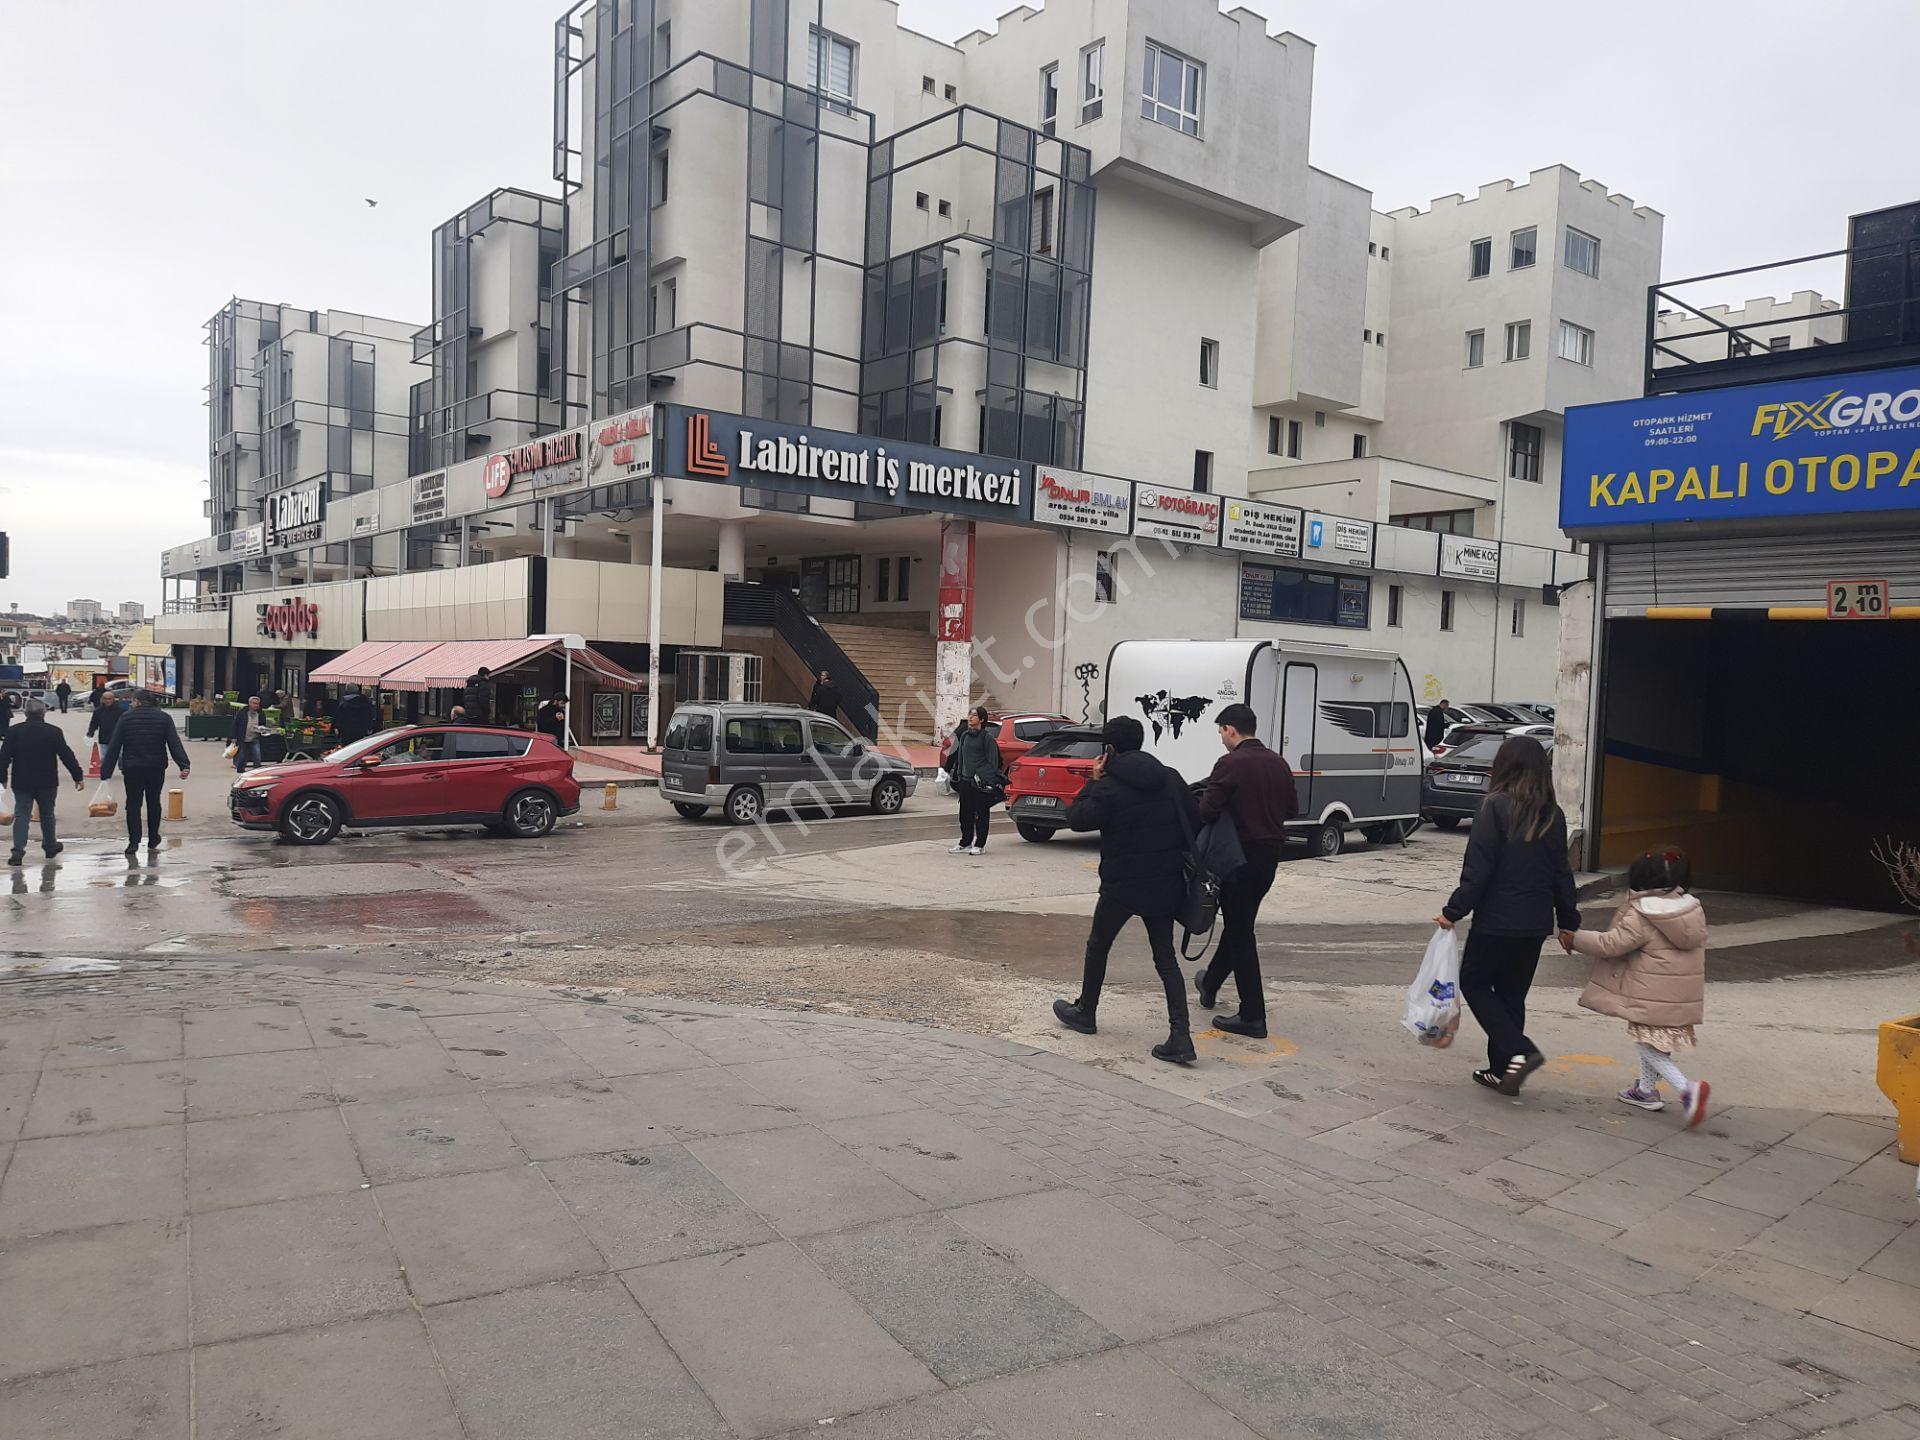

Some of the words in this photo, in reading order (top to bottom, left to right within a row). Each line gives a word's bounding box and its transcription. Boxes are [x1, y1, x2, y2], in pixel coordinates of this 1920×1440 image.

[1633, 416, 1676, 427] OTOPARK
[1677, 412, 1713, 423] HİZMET
[1649, 423, 1694, 436] SAATLERİ
[1814, 429, 1850, 437] TOPTAN
[486, 461, 506, 490] LIFE
[739, 430, 870, 486] Labirent
[876, 447, 900, 496] iş
[908, 461, 1021, 506] merkezi
[1589, 462, 1748, 508] KAPALI
[1049, 485, 1091, 503] ONUR
[1092, 492, 1128, 510] EMLAK
[1158, 495, 1219, 520] FOTOĞRAFÇI
[276, 486, 320, 531] Labirent
[1048, 502, 1067, 510] arsa
[1075, 506, 1096, 514] daire
[1103, 510, 1119, 518] villa
[1244, 509, 1260, 520] DİŞ
[1263, 513, 1296, 524] HEKİMİ
[287, 527, 318, 544] MERKEZİ
[1834, 586, 1847, 612] 2
[1857, 584, 1879, 595] m
[1856, 597, 1882, 611] 10
